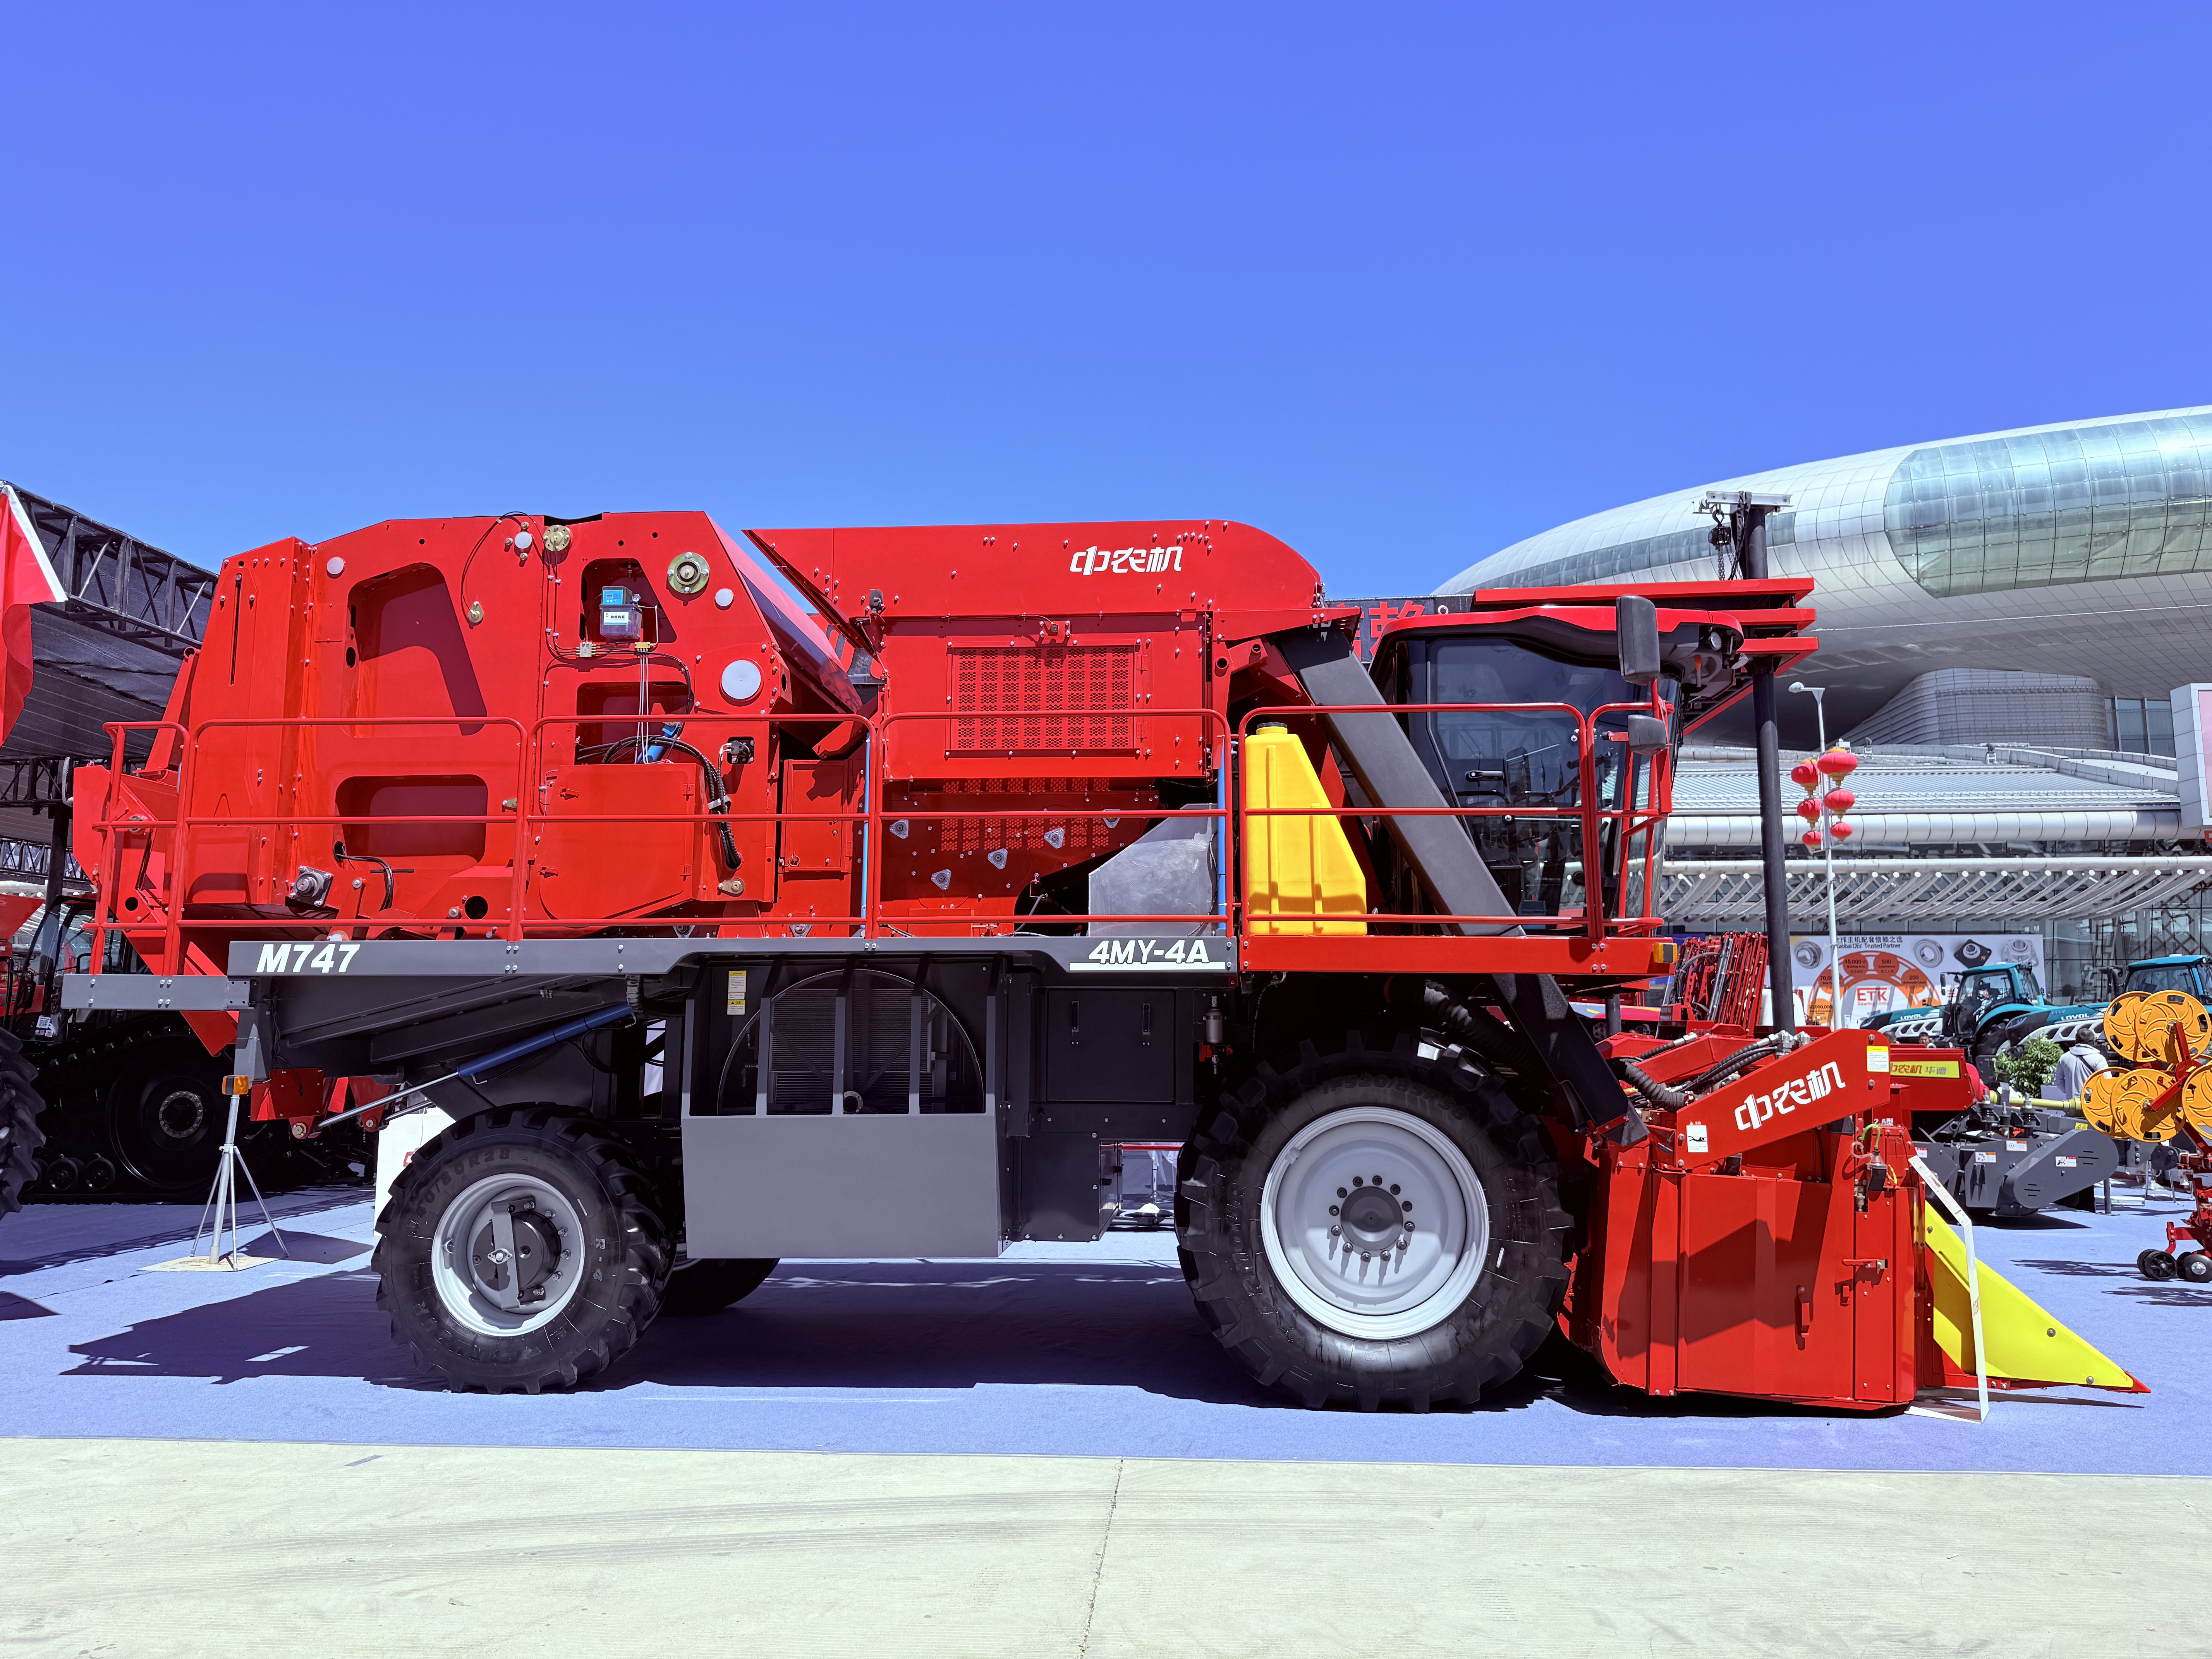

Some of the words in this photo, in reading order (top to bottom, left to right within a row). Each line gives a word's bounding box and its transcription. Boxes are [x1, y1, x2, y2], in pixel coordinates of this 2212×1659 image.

[1070, 546, 1183, 575] 中农机
[256, 944, 361, 973] M747
[1089, 939, 1209, 964] 4MY-4A
[1857, 988, 1887, 1001] ETK
[1734, 1061, 1846, 1130] 中农机
